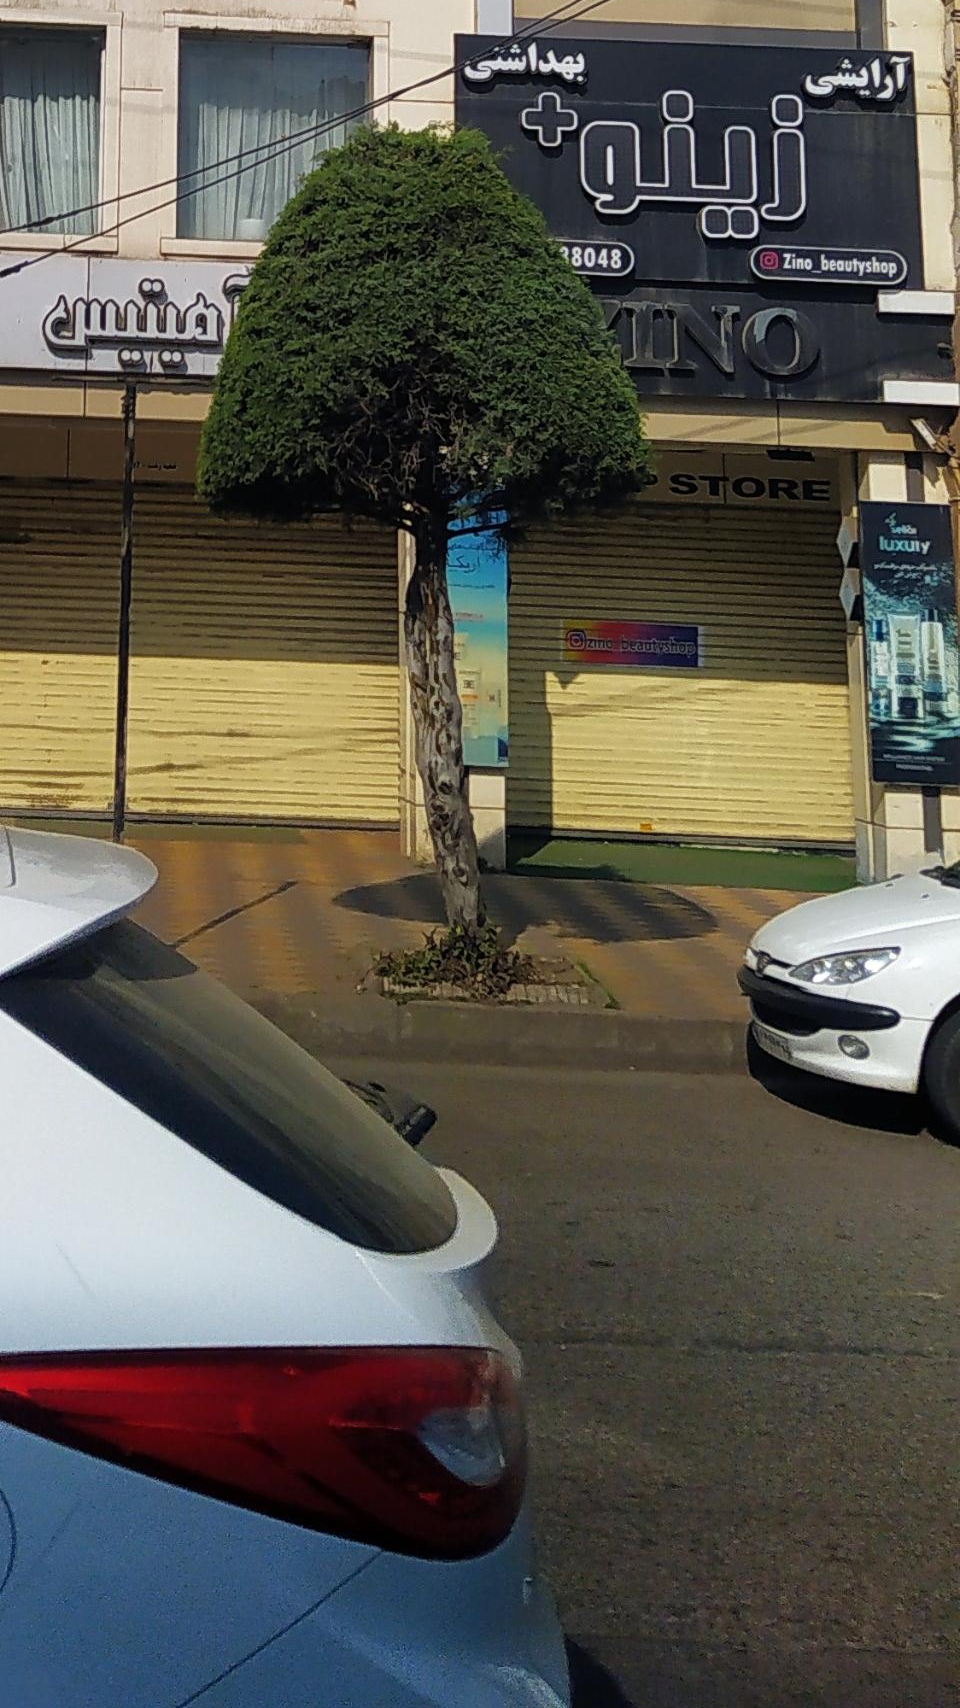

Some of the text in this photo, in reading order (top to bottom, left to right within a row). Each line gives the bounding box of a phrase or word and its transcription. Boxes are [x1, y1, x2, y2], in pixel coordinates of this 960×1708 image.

[463, 41, 587, 84] بهداشتی
[803, 55, 912, 100] آرایشی
[580, 90, 807, 239] زینو
[782, 252, 898, 278] Zino_beautyshop
[600, 298, 821, 376] INO
[668, 473, 832, 502] STORE
